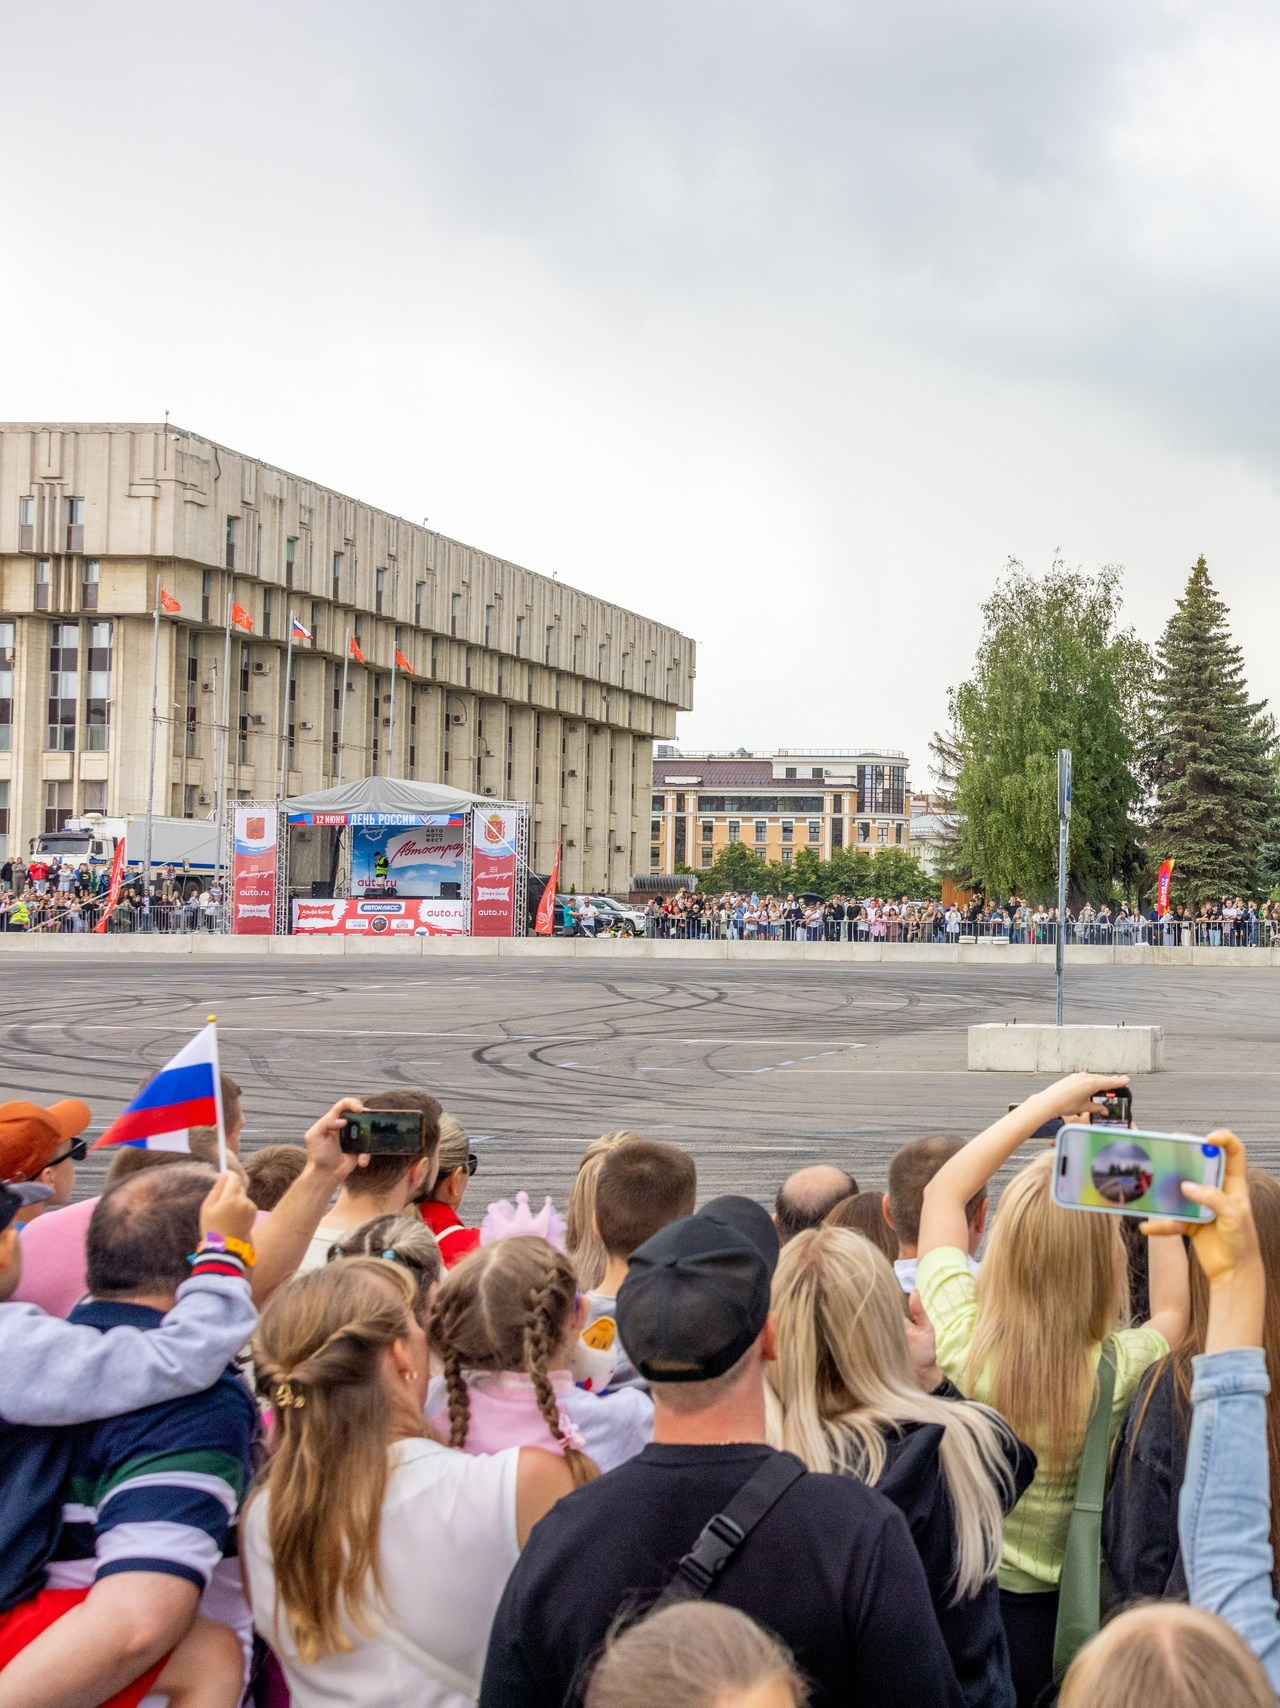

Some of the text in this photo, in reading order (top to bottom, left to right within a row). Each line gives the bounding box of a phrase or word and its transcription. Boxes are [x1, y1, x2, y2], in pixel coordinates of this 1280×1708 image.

[316, 815, 345, 824] 12 ИЮНЯ
[350, 813, 415, 825] ДЕНЬ РОССИИ
